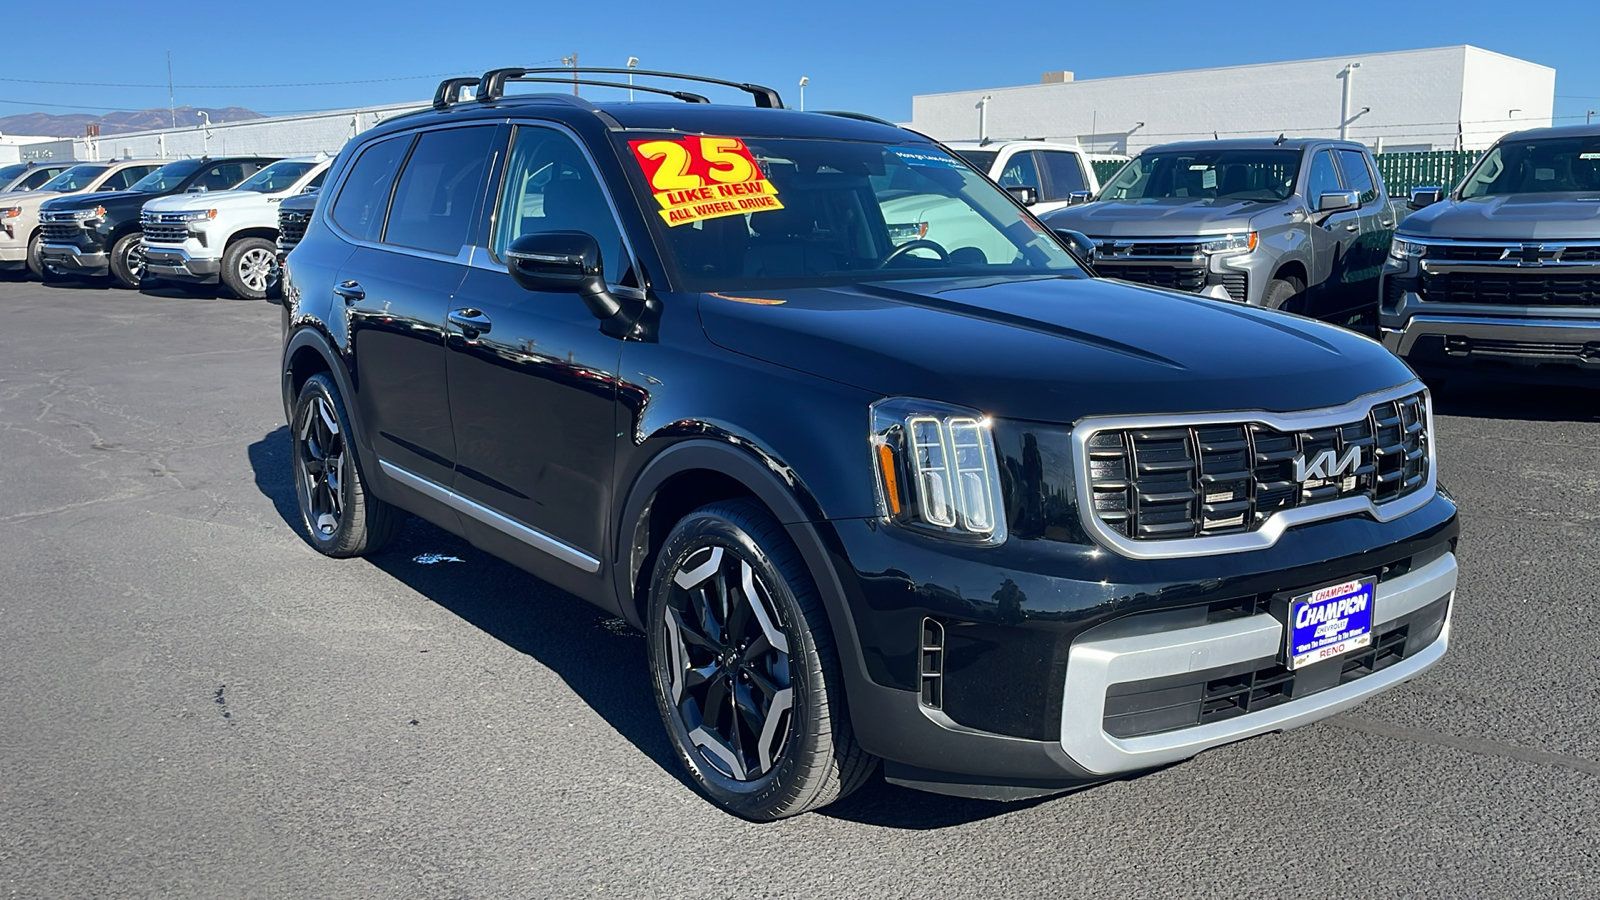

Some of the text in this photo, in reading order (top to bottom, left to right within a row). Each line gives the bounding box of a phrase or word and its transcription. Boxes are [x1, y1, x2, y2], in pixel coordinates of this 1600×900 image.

[637, 137, 757, 191] 25
[666, 181, 763, 206] LIKE NEW
[669, 196, 775, 222] ALL WHEEL DRIVE
[1292, 445, 1361, 483] KIA
[1315, 582, 1356, 602] CHAMPION
[1295, 593, 1369, 629] CHAMPION
[1317, 620, 1346, 635] CHEVROLET
[1320, 643, 1345, 658] RENO
